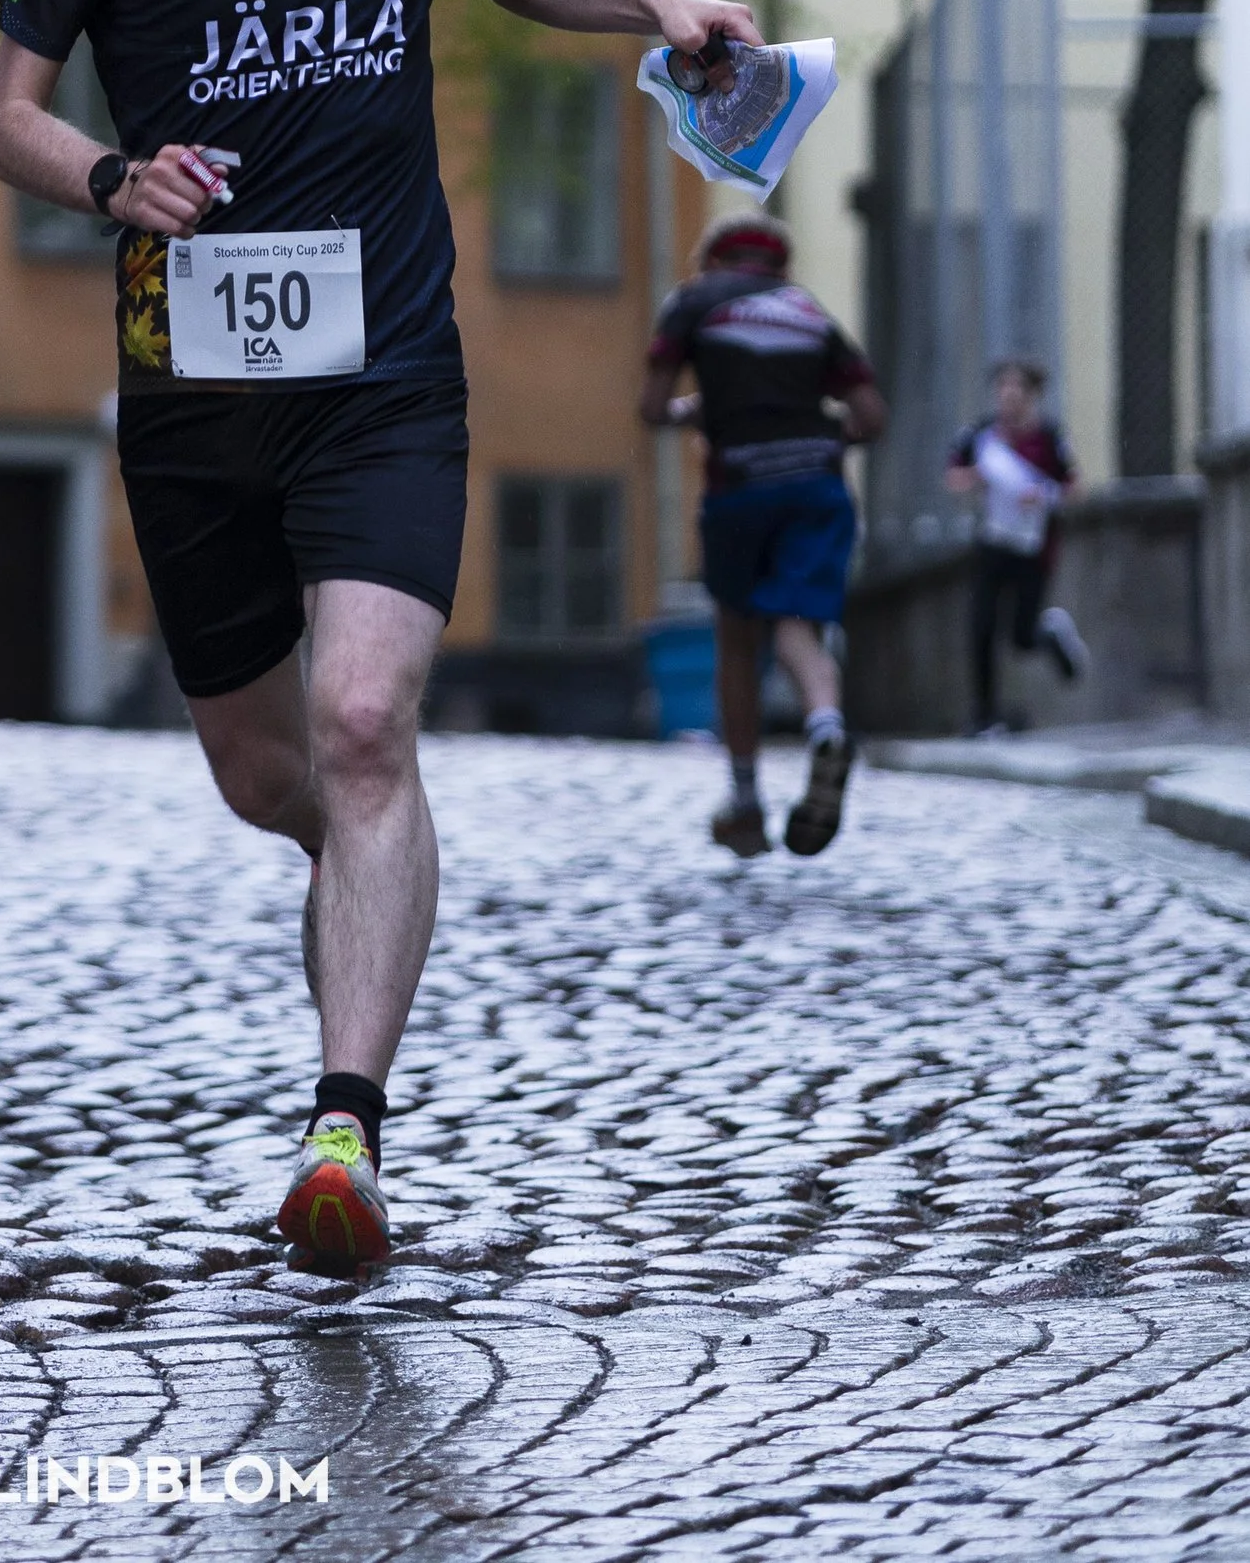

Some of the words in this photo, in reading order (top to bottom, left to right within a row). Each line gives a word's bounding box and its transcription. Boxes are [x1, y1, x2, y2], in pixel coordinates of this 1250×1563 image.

[188, 47, 405, 104] ORIENTERING
[213, 245, 269, 258] Stockholm
[272, 245, 293, 258] City
[296, 244, 318, 257] Cup
[320, 242, 345, 254] 2025
[214, 270, 310, 332] 150
[243, 337, 282, 356] ICA
[262, 356, 283, 364] nära
